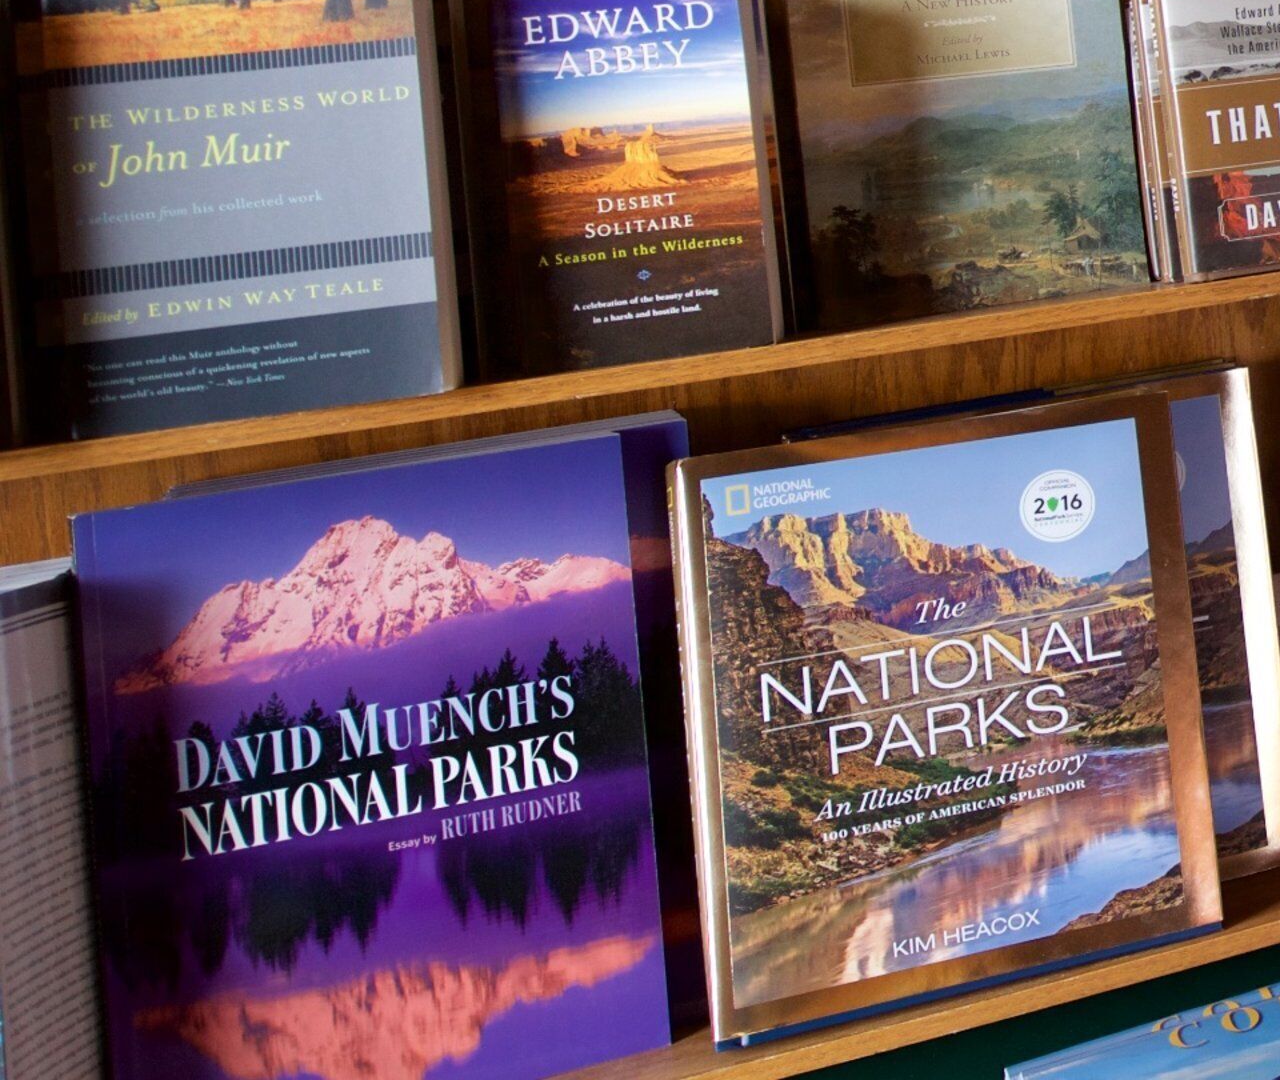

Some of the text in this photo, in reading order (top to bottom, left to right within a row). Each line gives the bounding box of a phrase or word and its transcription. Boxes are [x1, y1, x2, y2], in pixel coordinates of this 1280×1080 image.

[522, 1, 715, 45] EDWARD
[554, 39, 690, 79] ABBEY
[1228, 42, 1245, 54] the
[73, 133, 290, 187] OF John Muir
[584, 214, 694, 239] SOLITAIRE
[597, 193, 676, 214] DESERT
[538, 235, 743, 267] A Season in the Wilderness
[754, 478, 814, 496] NATIONAL
[754, 488, 831, 508] GEOGRAPHIC
[915, 597, 967, 624] The
[760, 616, 1122, 724] NATIONAL
[174, 675, 575, 793] DAVID MUENCH'S
[829, 684, 1069, 775] PARKS
[178, 730, 579, 862] NATIONAL PARKS
[814, 753, 1088, 821] An Illustrated History
[388, 791, 582, 851] Essay by RUTH RUDNER
[821, 779, 1085, 842] 100 YEARS OF AMERICAN SPLENDOR
[893, 909, 1040, 958] KIM HEACOX
